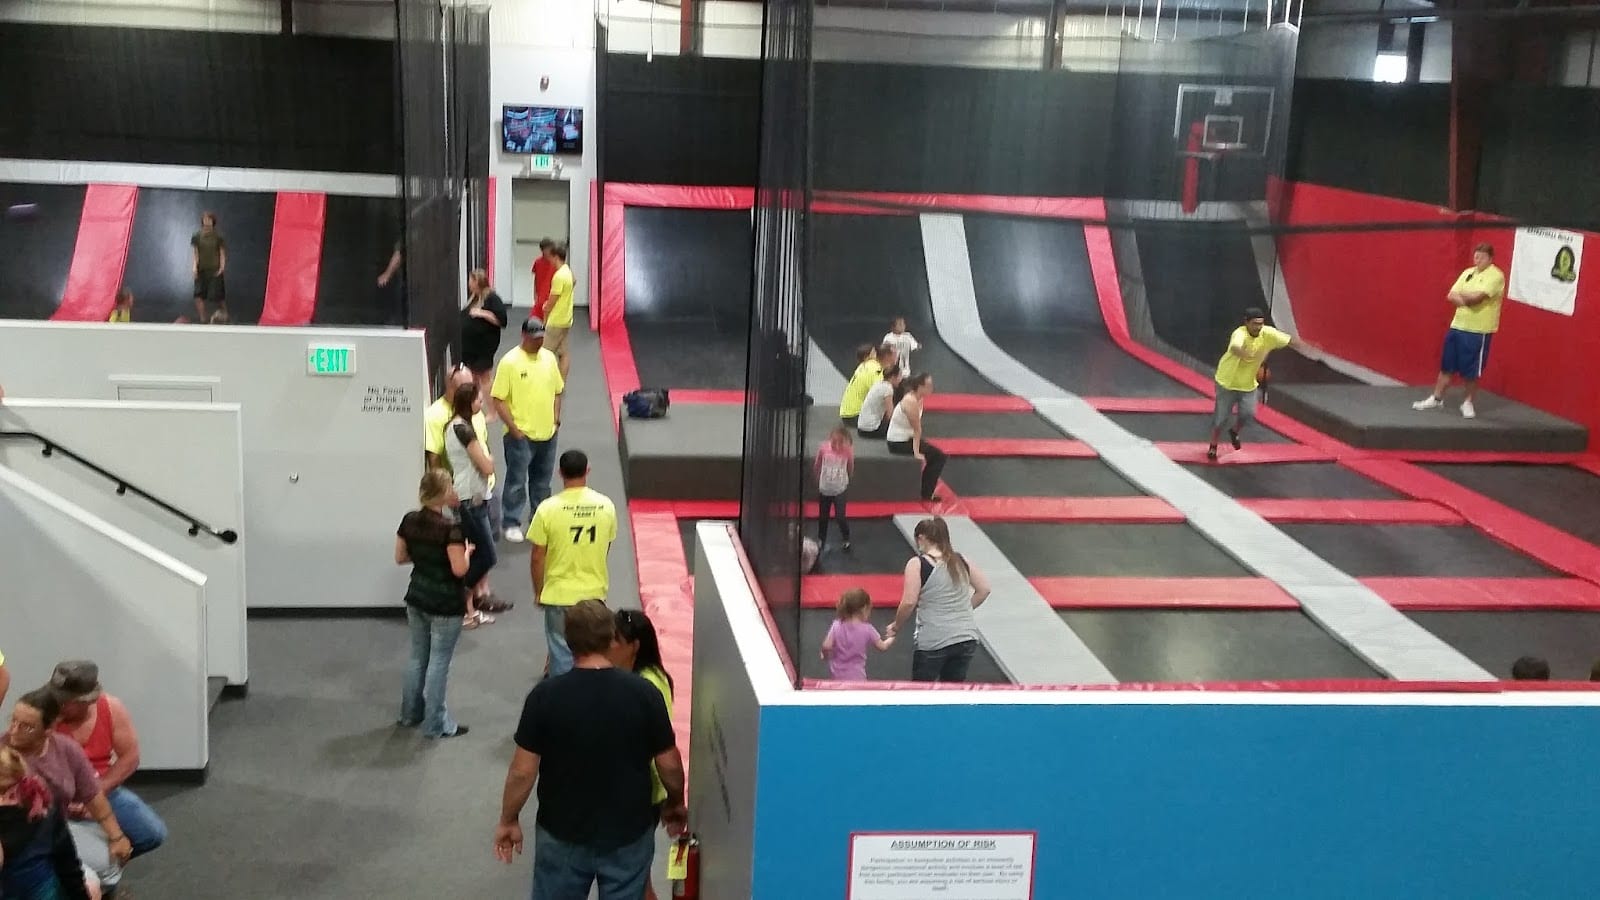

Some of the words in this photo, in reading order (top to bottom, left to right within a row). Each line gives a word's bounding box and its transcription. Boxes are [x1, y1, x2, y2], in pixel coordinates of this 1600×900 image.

[316, 348, 348, 372] EXIT
[367, 386, 379, 394] No
[383, 386, 404, 395] Food
[376, 395, 397, 403] Drink
[361, 404, 384, 413] Jump
[387, 404, 411, 412] Areas
[570, 525, 596, 544] 71
[891, 839, 955, 849] ASSUMPTION
[958, 839, 971, 849] OF
[974, 839, 996, 849] RISK
